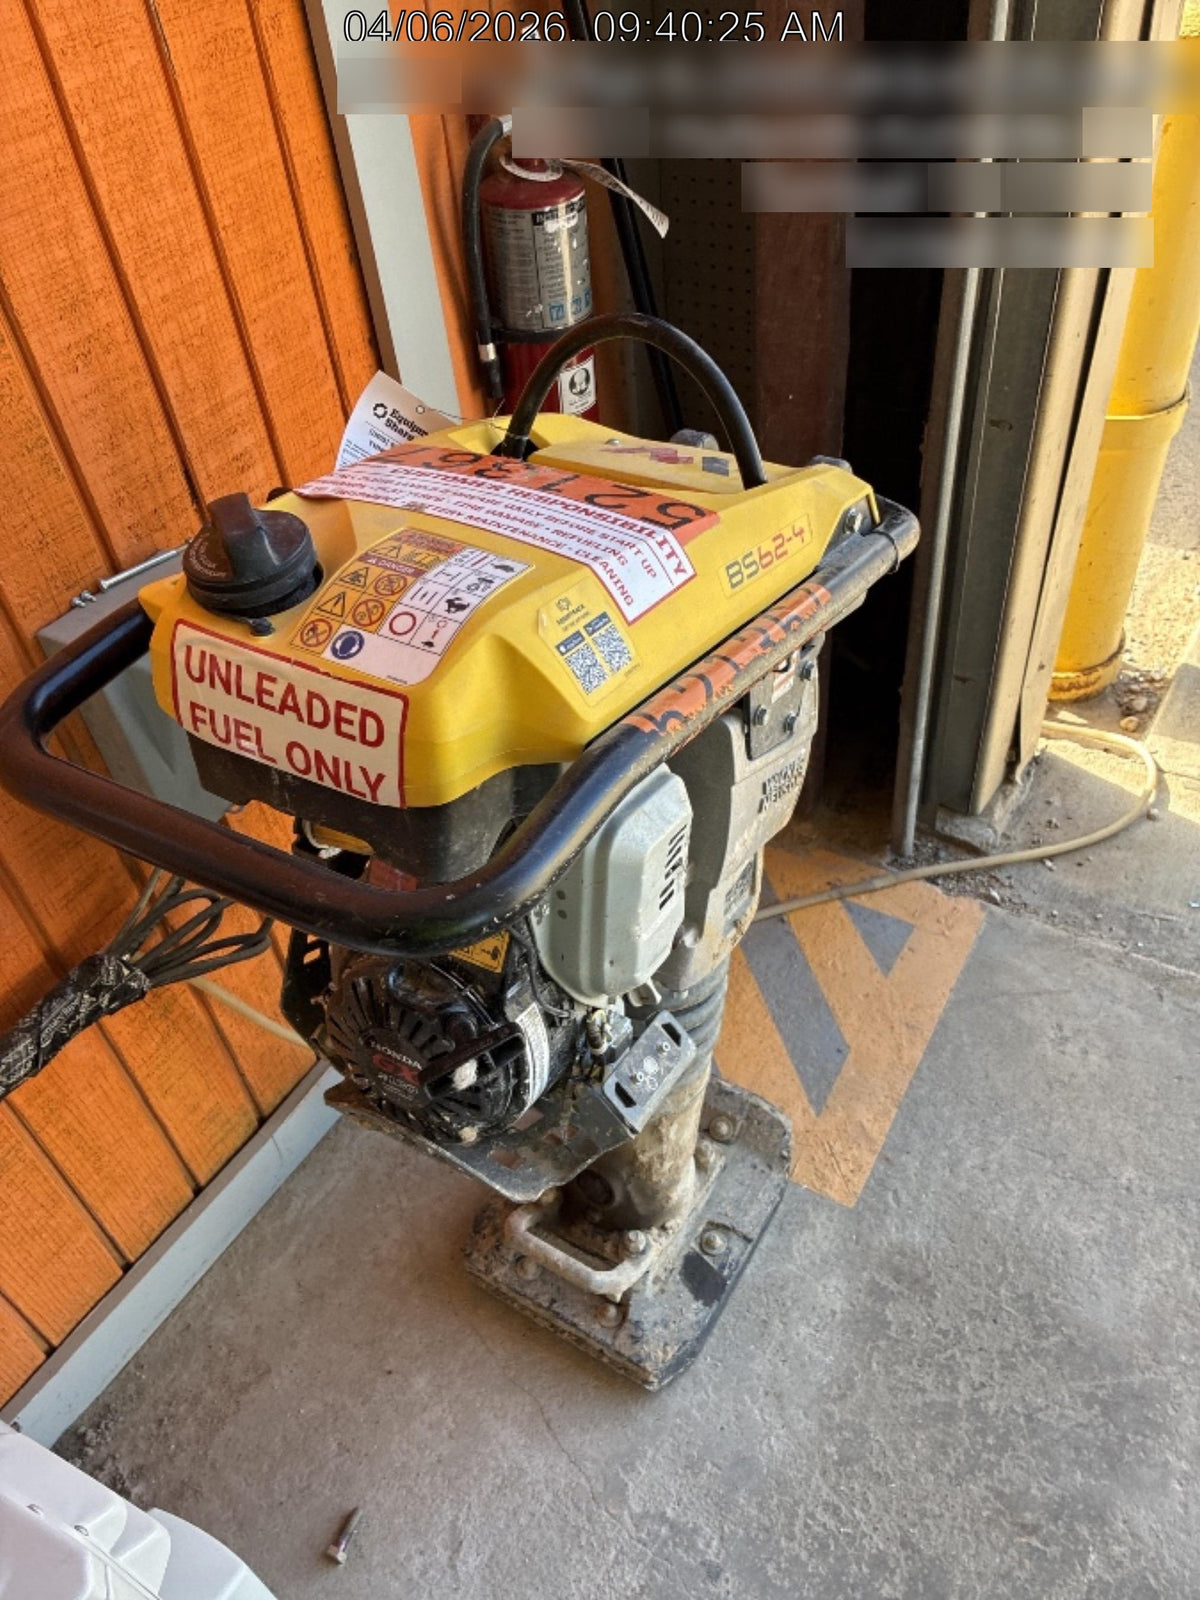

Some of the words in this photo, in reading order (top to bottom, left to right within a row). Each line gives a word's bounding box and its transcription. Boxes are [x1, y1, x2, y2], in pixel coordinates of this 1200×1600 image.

[507, 487, 688, 577] RESPONSIBILITY
[551, 528, 629, 567] REFUELING
[600, 532, 643, 557] START
[641, 558, 657, 579] UP
[725, 524, 805, 589] BS62-4
[574, 550, 634, 607] CLEANING
[185, 644, 385, 748] UNLEADED
[189, 700, 278, 766] FUEL
[285, 740, 387, 803] ONLY
